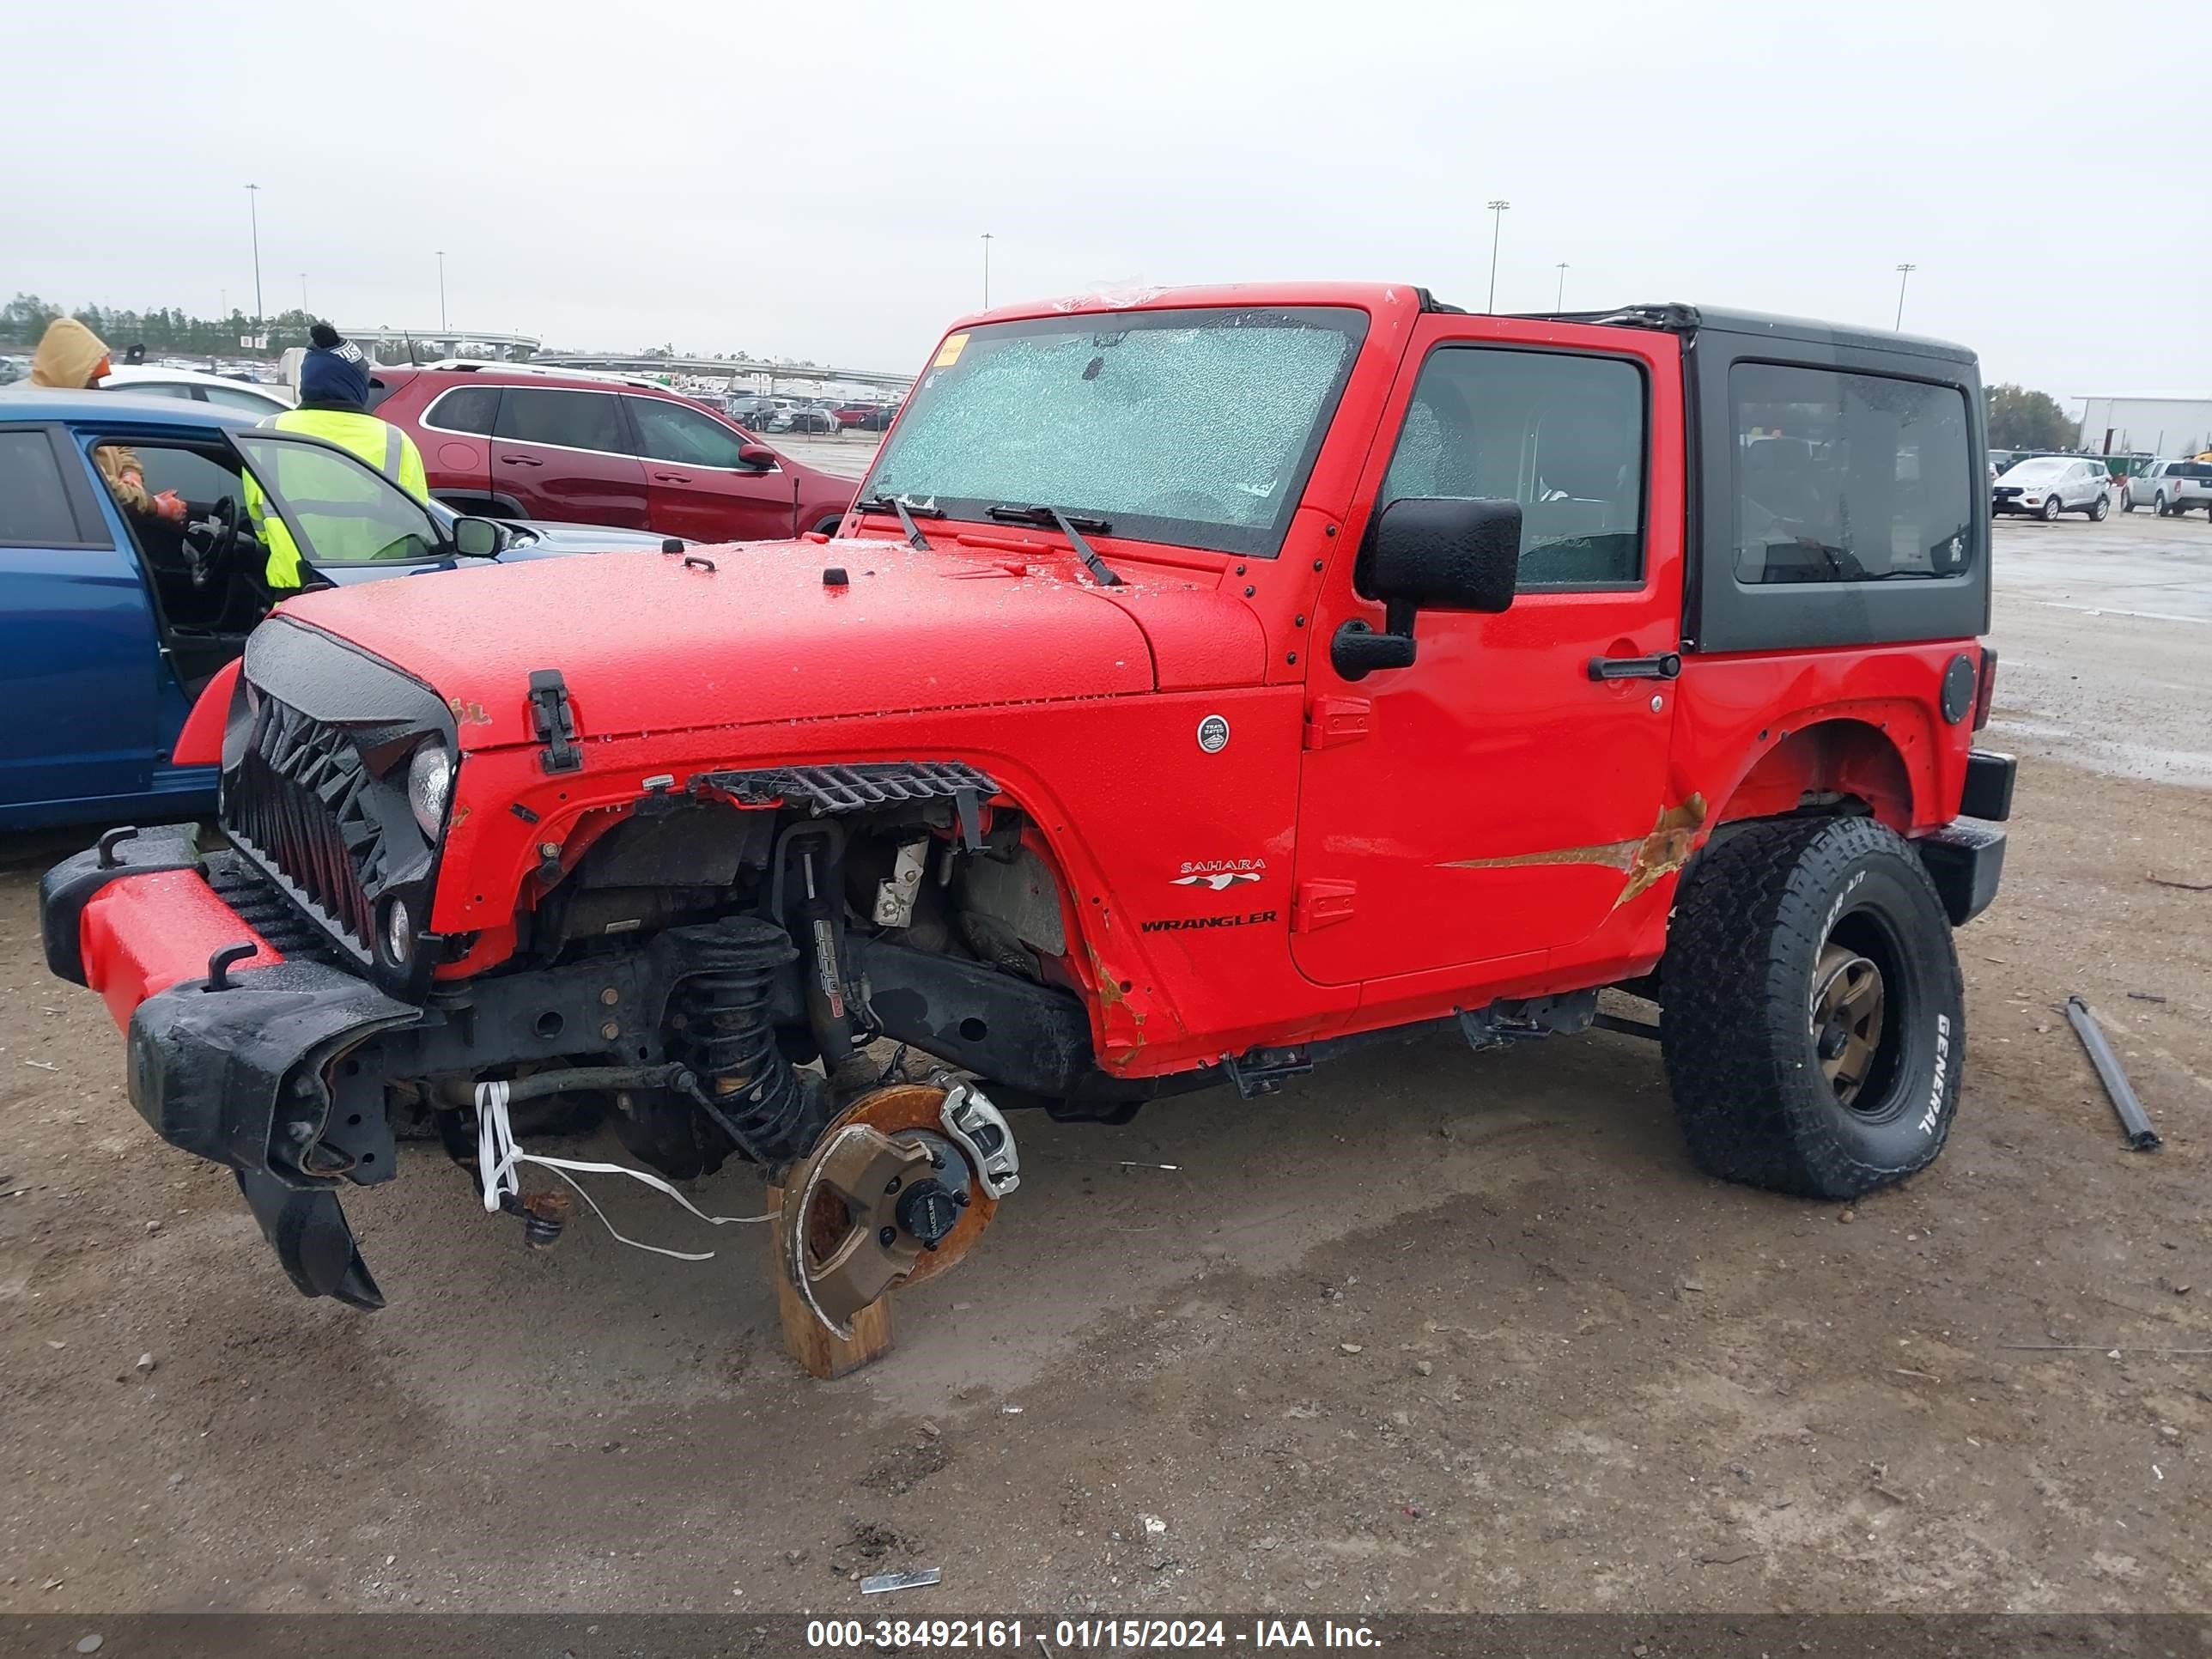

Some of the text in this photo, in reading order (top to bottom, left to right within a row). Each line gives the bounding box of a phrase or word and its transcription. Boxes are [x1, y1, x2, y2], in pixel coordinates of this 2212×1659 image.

[1180, 859, 1267, 873] SAHARA
[1140, 909, 1278, 933] WRANGLER
[1917, 1013, 1951, 1136] GENERAL
